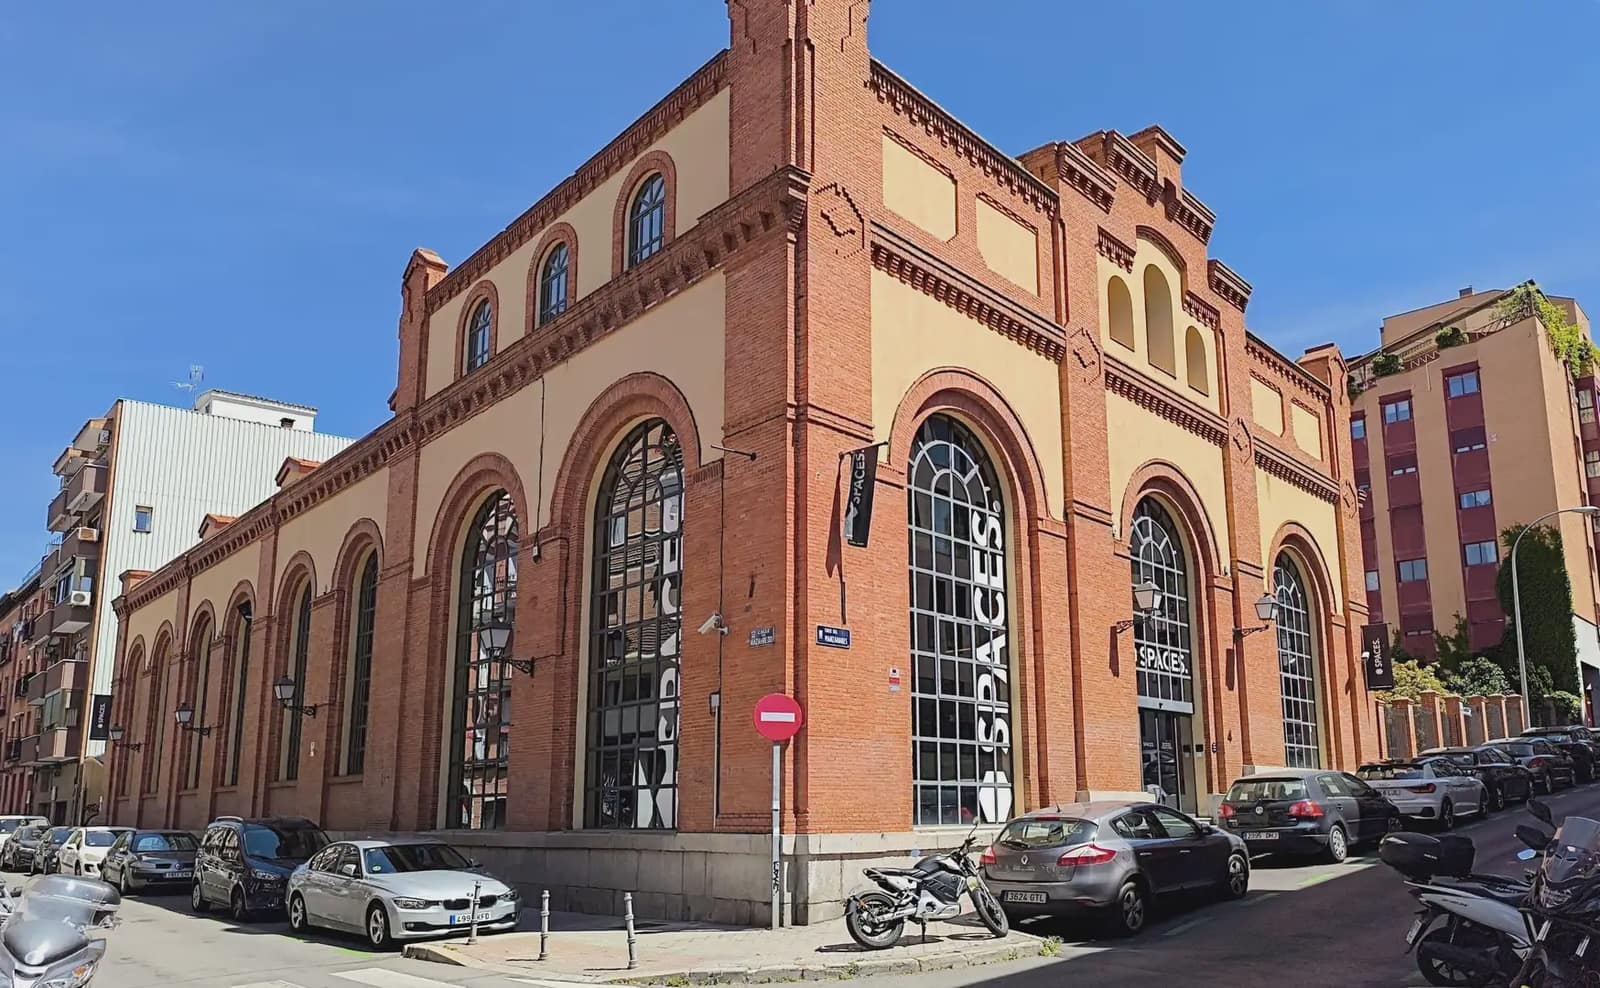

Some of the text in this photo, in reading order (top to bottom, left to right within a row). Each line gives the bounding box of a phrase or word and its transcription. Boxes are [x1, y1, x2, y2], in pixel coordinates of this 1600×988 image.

[972, 500, 1010, 754] SPACES.
[1140, 645, 1189, 675] SPACES.
[1008, 892, 1028, 901] 3624
